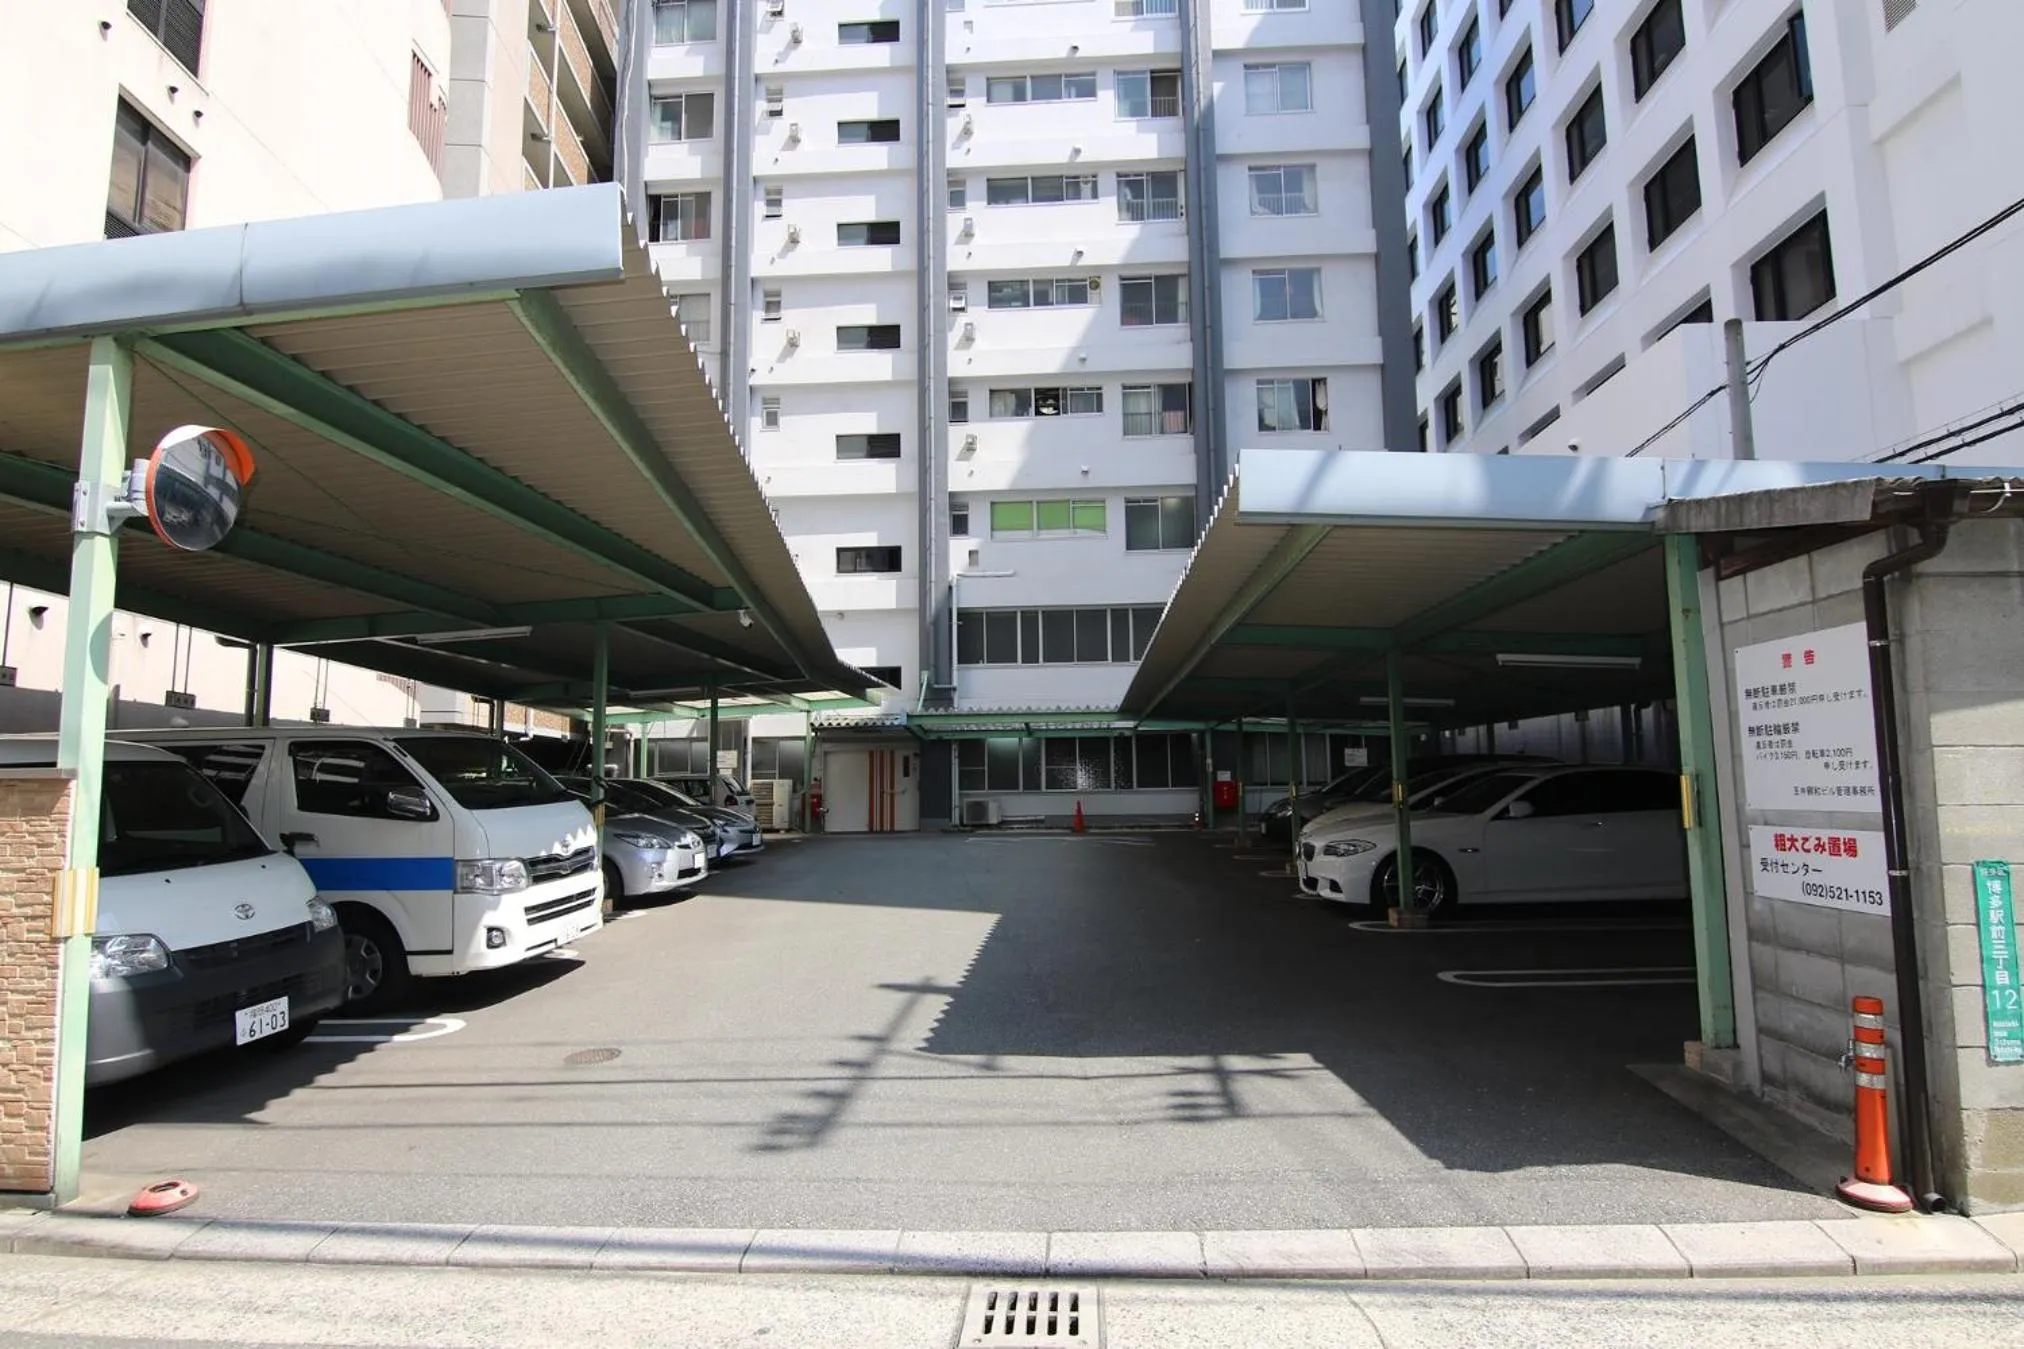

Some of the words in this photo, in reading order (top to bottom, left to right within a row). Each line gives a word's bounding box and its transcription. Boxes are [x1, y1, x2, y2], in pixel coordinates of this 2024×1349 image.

[1774, 833, 1858, 858] 粗大ごみ置場
[1760, 857, 1823, 876] 受付センター
[1802, 881, 1884, 906] (092)521-1153
[1986, 879, 2010, 985] 博多駅前三丁目
[1992, 989, 2018, 1010] 12
[249, 1011, 286, 1038] 61-03
